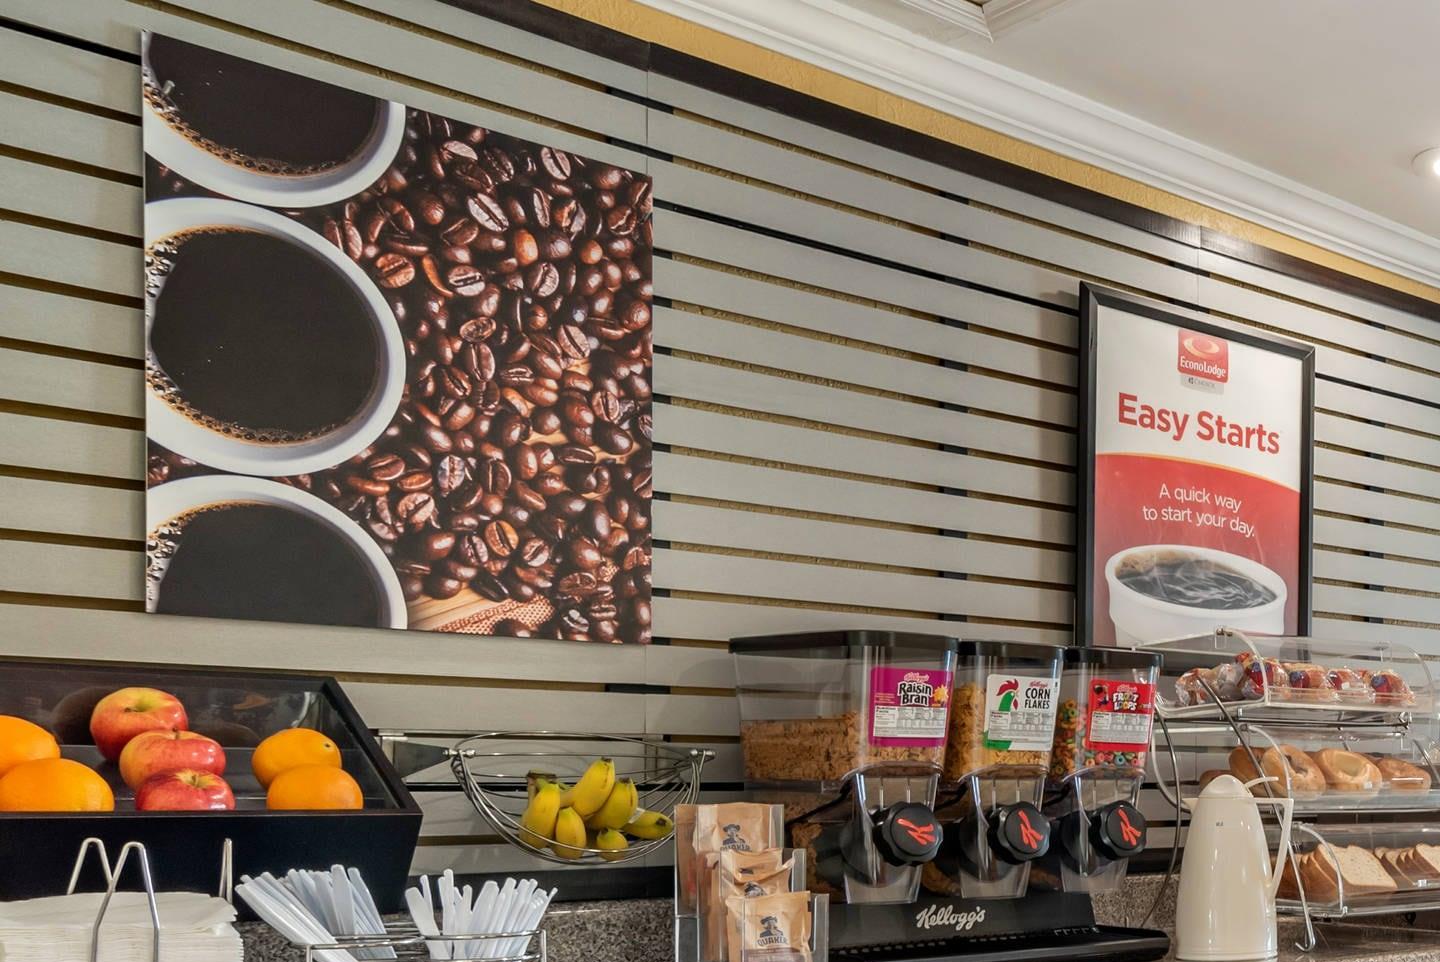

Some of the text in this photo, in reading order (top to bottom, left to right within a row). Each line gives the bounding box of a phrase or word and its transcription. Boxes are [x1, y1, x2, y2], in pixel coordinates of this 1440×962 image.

[1118, 392, 1280, 455] Easy Starts
[1159, 483, 1241, 513] A quick way
[1142, 506, 1255, 537] to start your day.
[898, 681, 933, 697] Raisin
[1025, 688, 1051, 700] CORN
[901, 694, 929, 706] Bran
[1024, 699, 1050, 709] FLAKES
[915, 904, 986, 931] Kellogg's
